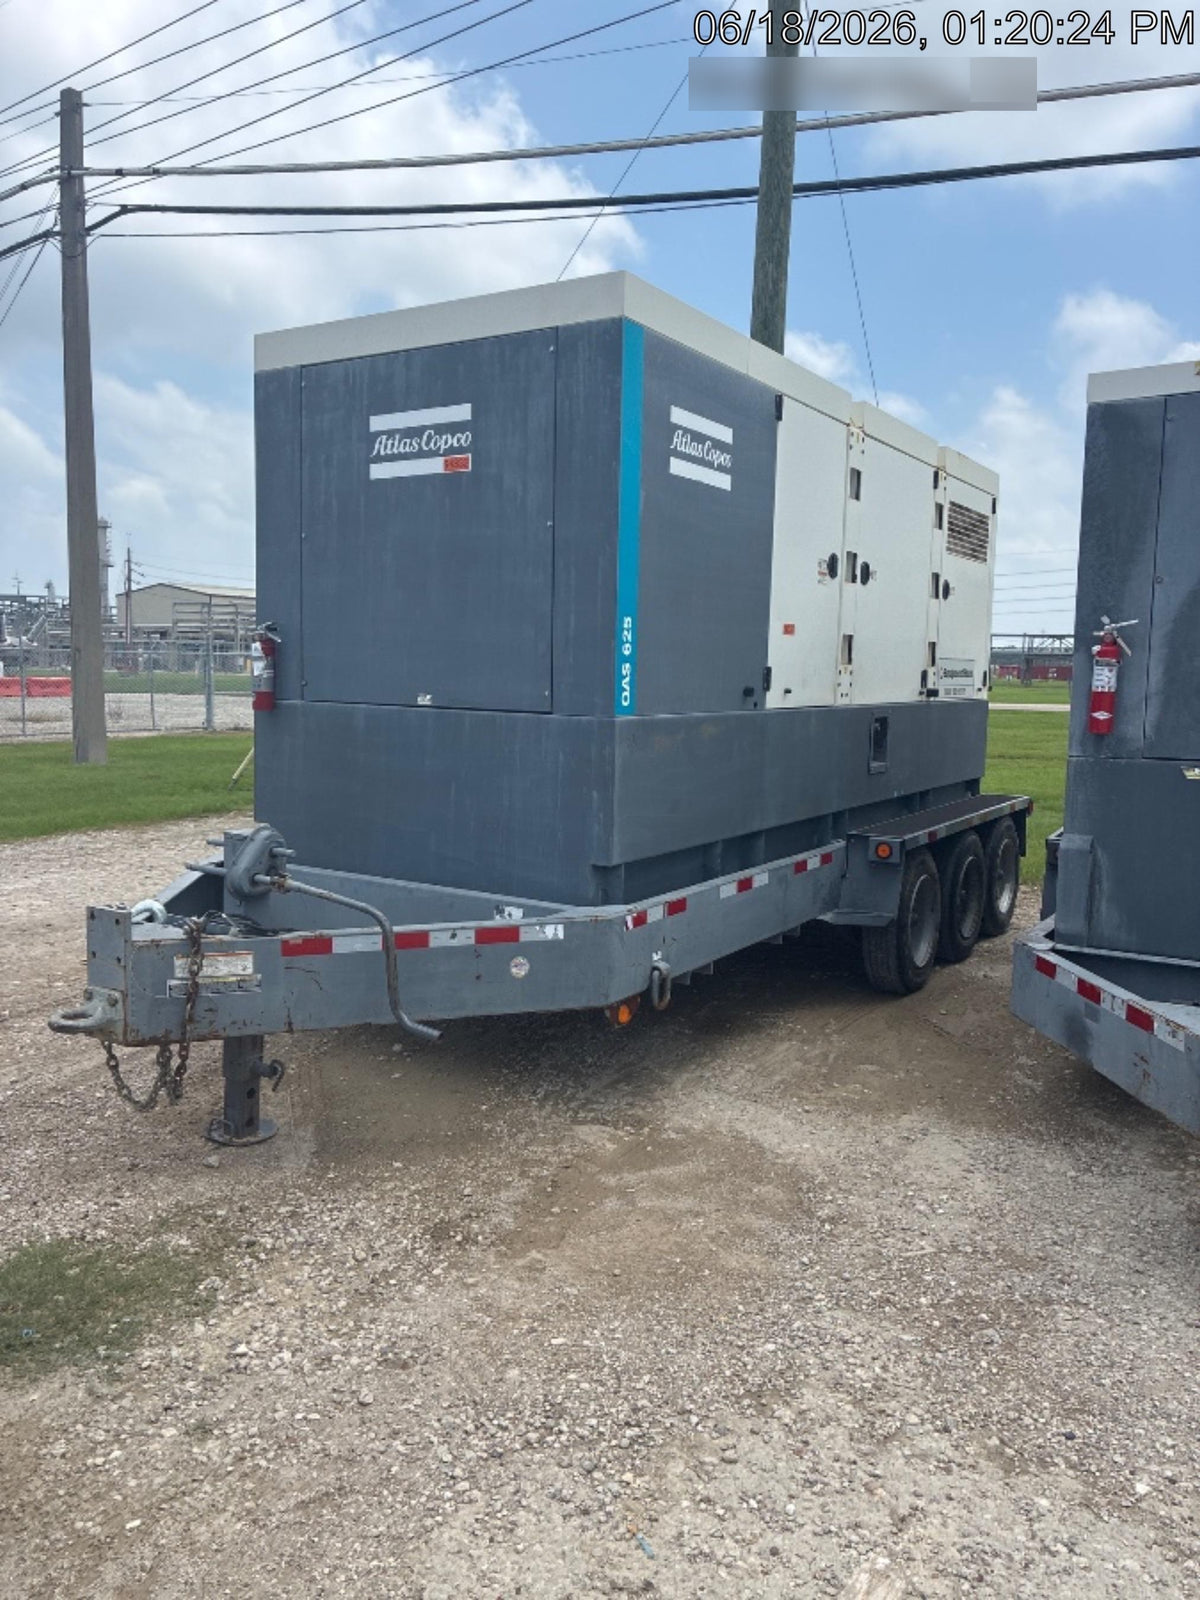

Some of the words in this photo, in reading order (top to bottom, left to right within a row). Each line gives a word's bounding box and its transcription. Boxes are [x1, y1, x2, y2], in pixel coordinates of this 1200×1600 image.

[371, 434, 419, 457] Atlas
[421, 430, 472, 454] Copco
[670, 430, 702, 457] Atlas
[704, 440, 731, 468] Copco
[622, 617, 632, 655] 625
